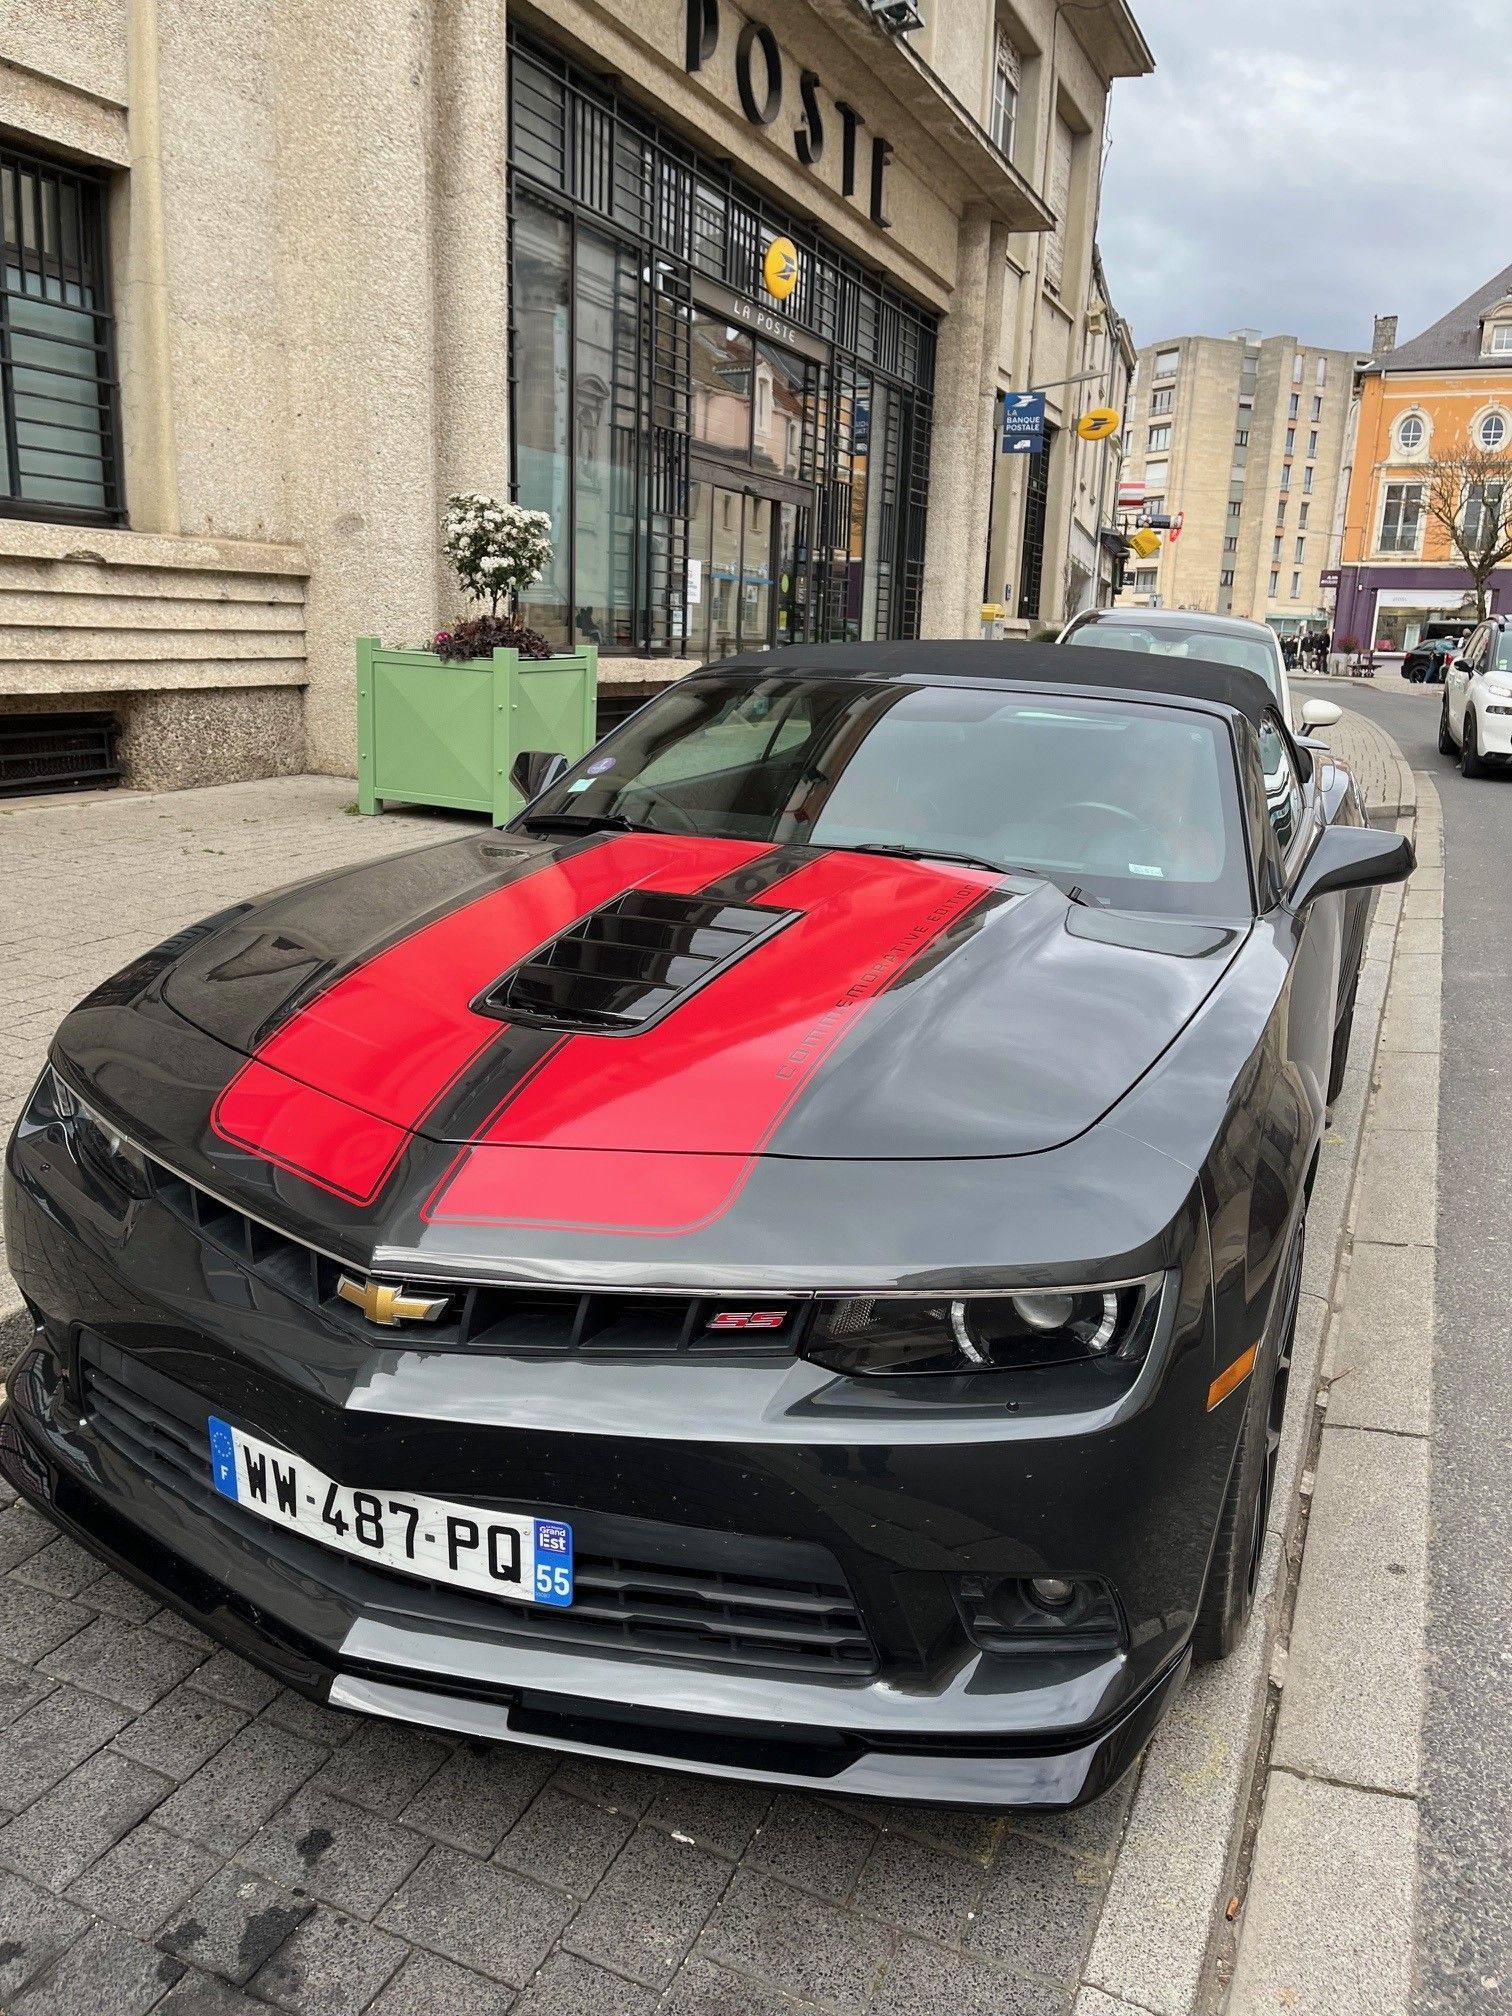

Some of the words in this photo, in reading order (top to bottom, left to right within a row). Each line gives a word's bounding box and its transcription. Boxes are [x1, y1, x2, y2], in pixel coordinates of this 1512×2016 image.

[686, 0, 894, 228] POSTE
[733, 300, 751, 319] LA
[757, 312, 796, 342] POSTE
[1006, 416, 1041, 424] BANQUE
[776, 925, 929, 1081] COMMEMORATIVE
[706, 1311, 787, 1328] SS
[221, 1465, 229, 1480] F
[243, 1444, 522, 1584] WW-487-PQ
[539, 1532, 567, 1551] Est
[540, 1525, 566, 1537] Grand
[536, 1563, 570, 1597] 55
